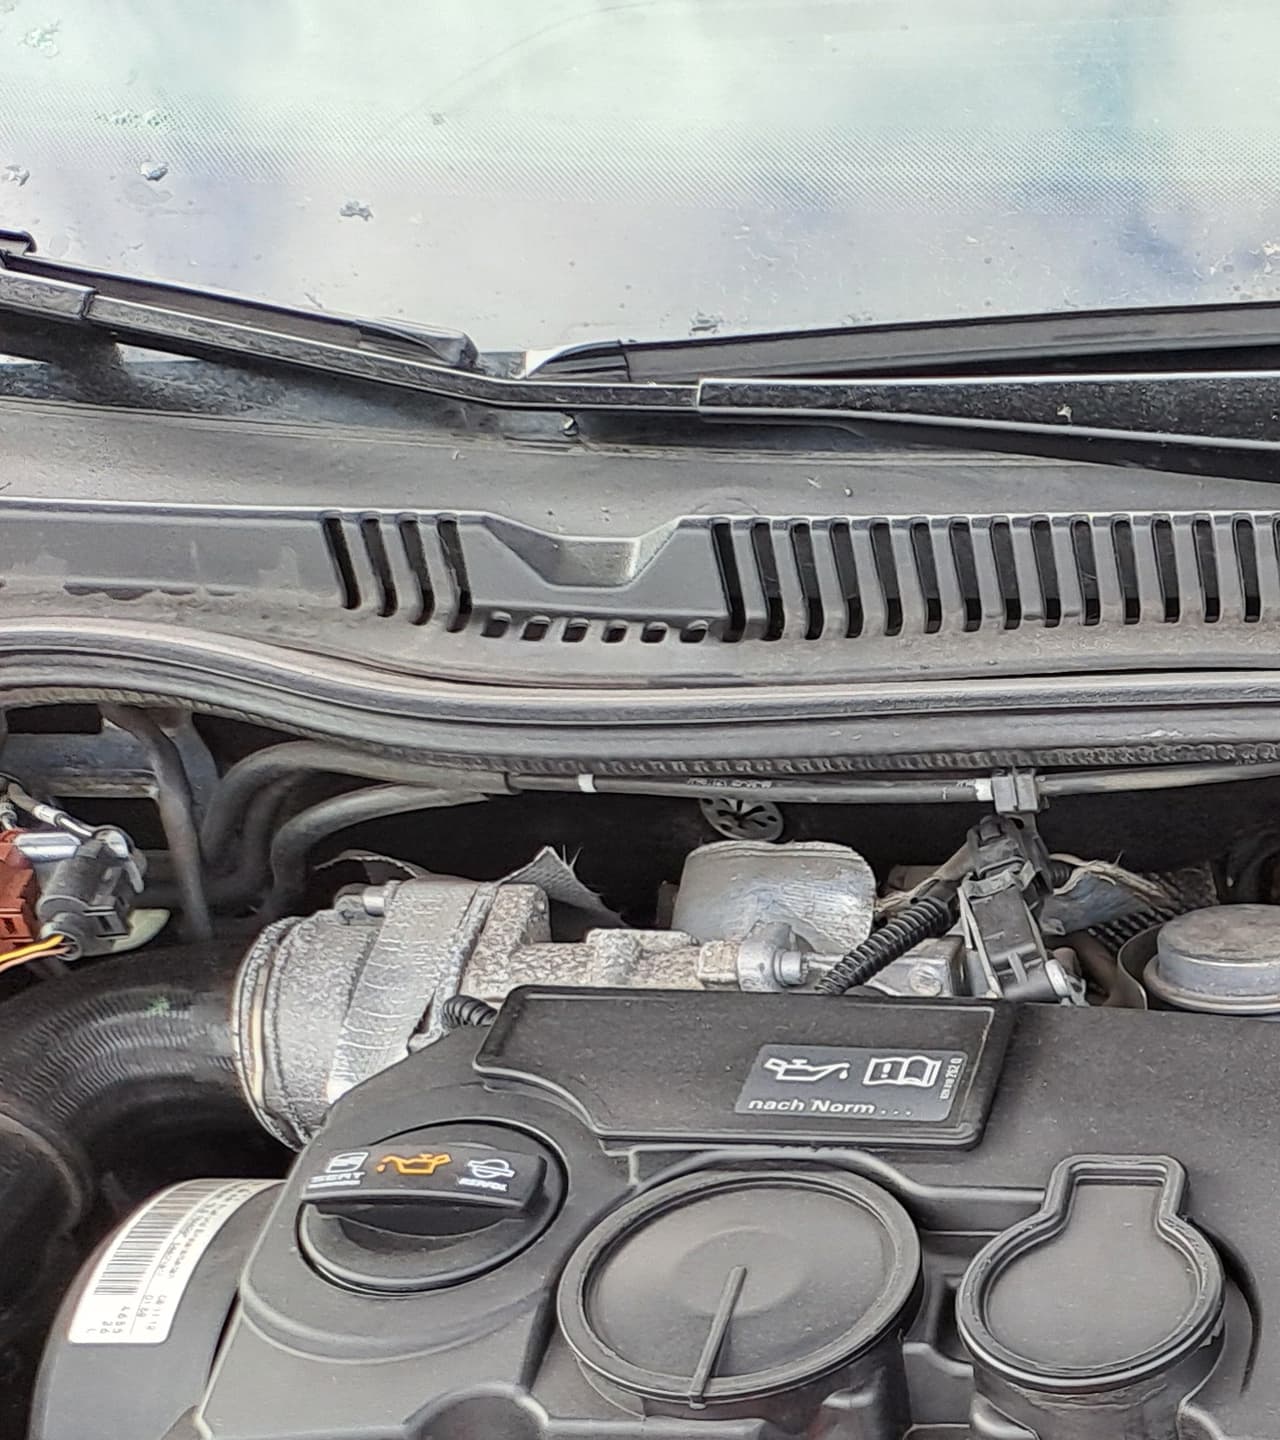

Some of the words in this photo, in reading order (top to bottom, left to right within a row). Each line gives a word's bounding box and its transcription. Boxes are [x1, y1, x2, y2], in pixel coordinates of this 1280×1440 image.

[748, 1098, 806, 1112] nach
[810, 1099, 876, 1114] Norm
[309, 1171, 366, 1184] SEAT
